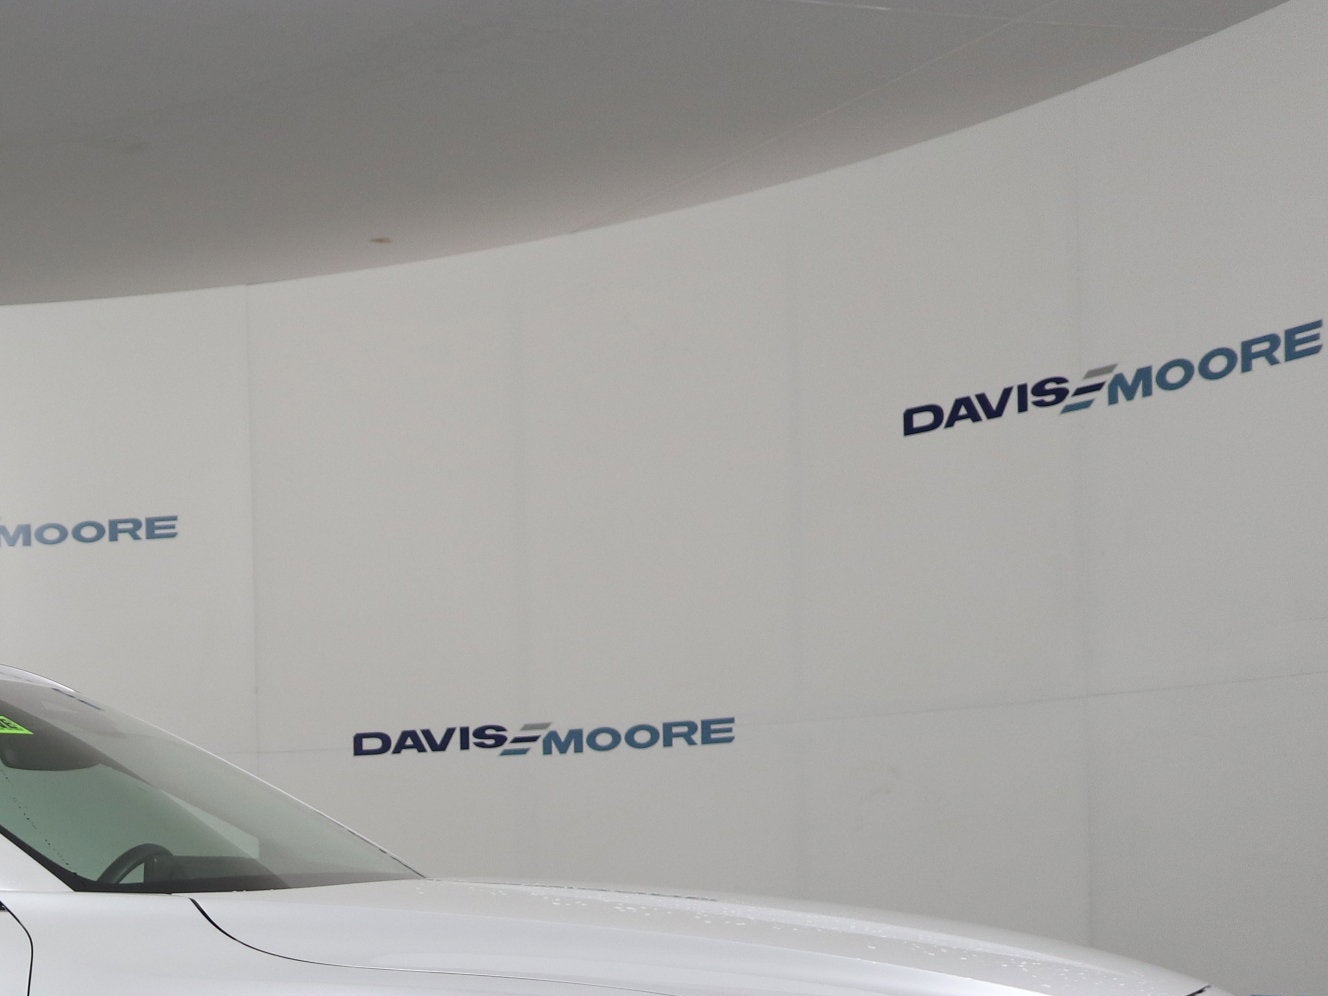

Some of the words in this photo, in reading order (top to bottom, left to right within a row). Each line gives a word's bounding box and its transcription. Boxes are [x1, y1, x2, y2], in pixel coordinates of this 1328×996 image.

[903, 375, 1070, 436] DAVIS
[1107, 318, 1324, 406] MOORE
[353, 724, 508, 756] DAVIS
[541, 717, 736, 756] MOORE
